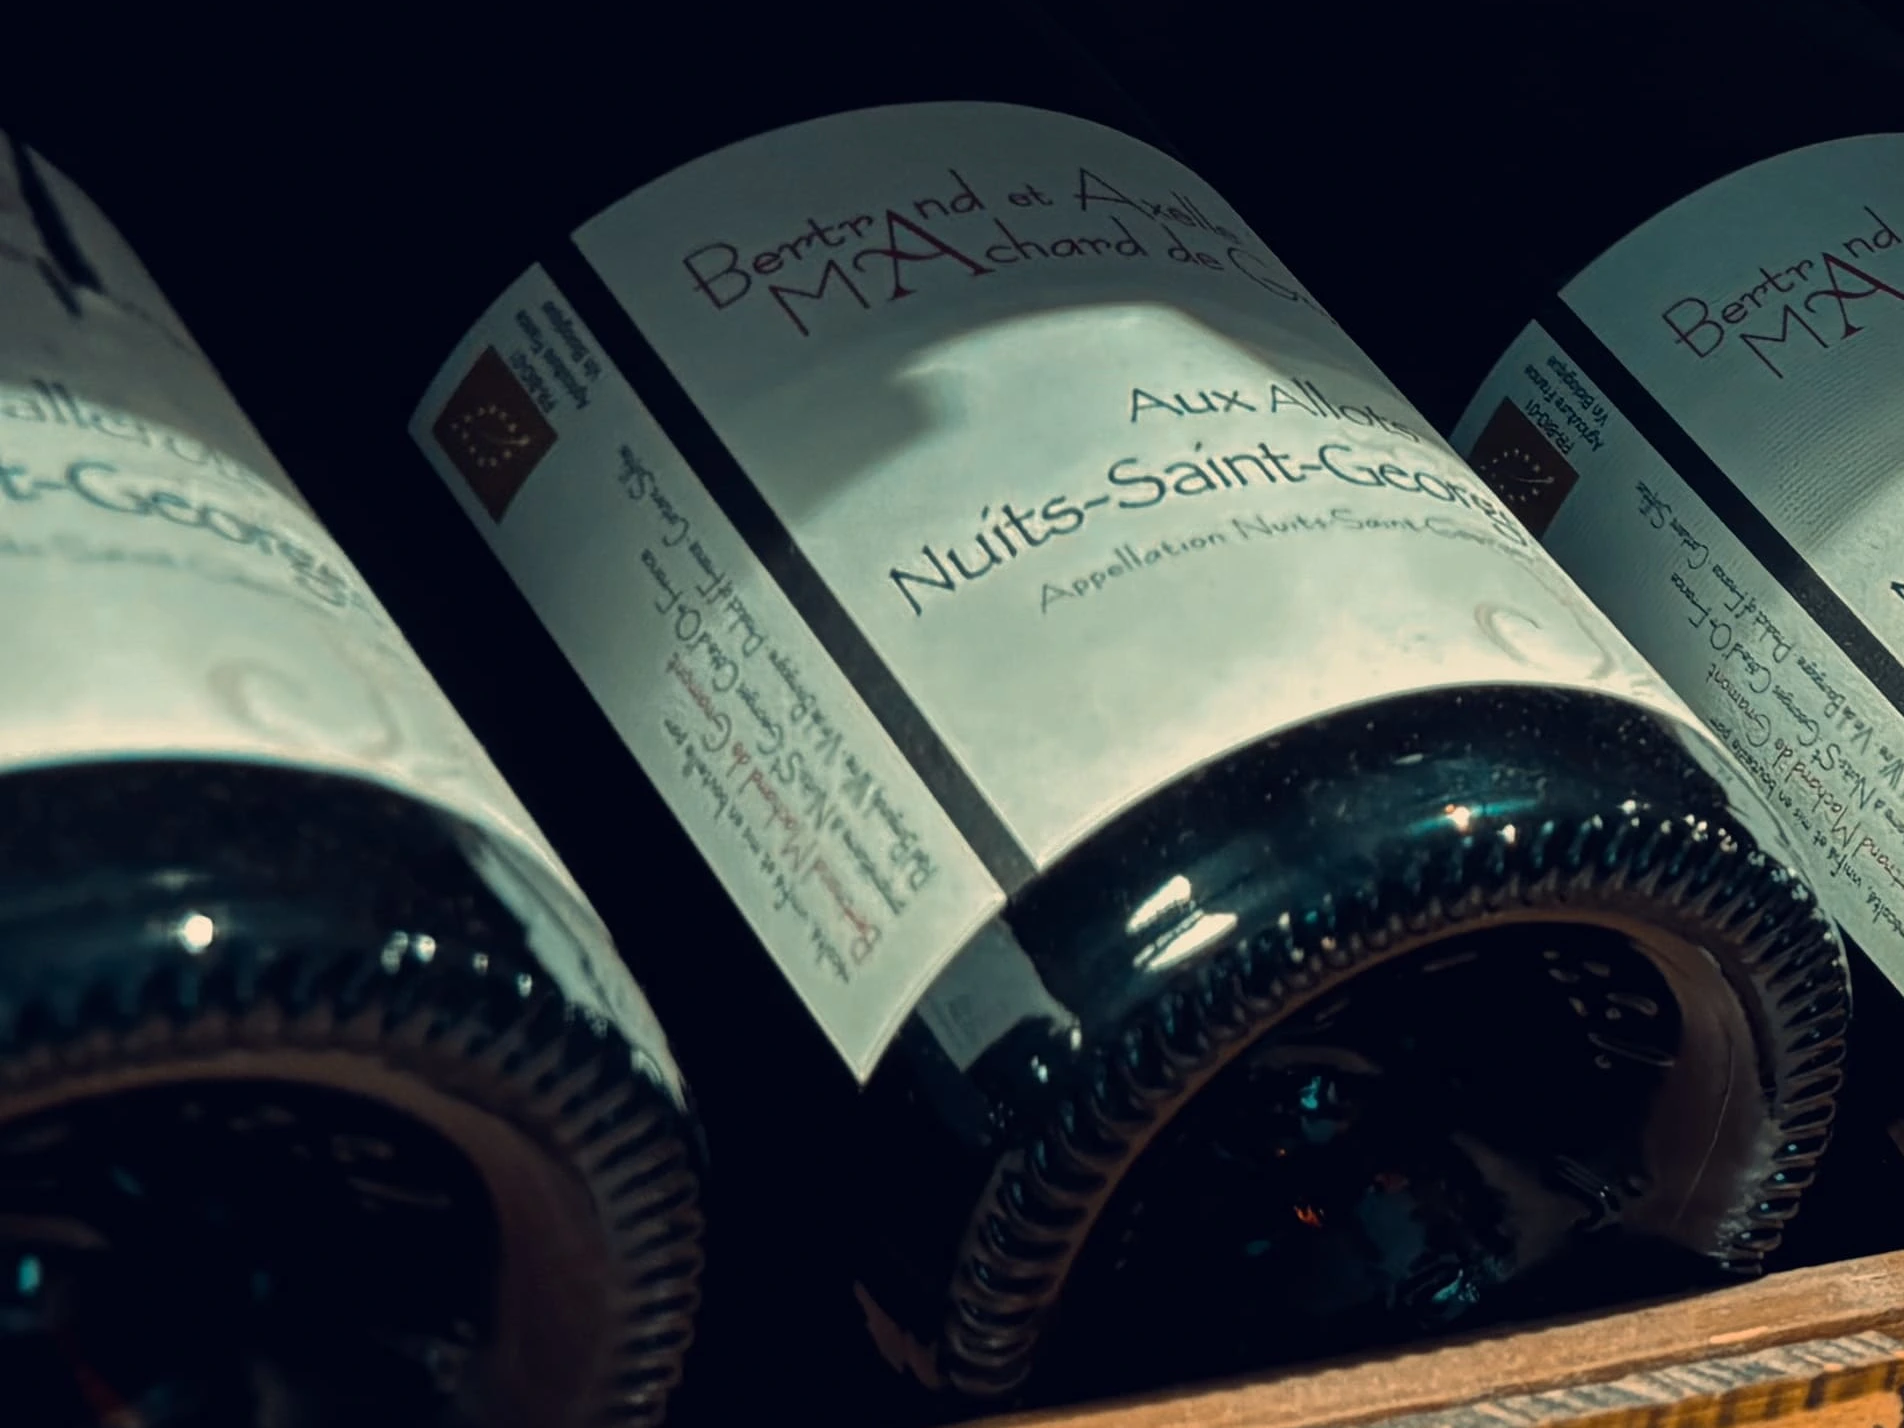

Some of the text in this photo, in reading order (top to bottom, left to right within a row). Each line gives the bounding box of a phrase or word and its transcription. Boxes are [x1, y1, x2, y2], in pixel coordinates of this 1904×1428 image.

[1007, 182, 1054, 209] et
[1166, 222, 1226, 271] de
[1130, 388, 1256, 423] Aux
[1041, 531, 1227, 614] Appellation
[1690, 659, 1781, 754] Gramont
[1758, 734, 1797, 773] de
[1777, 754, 1869, 850] Machard
